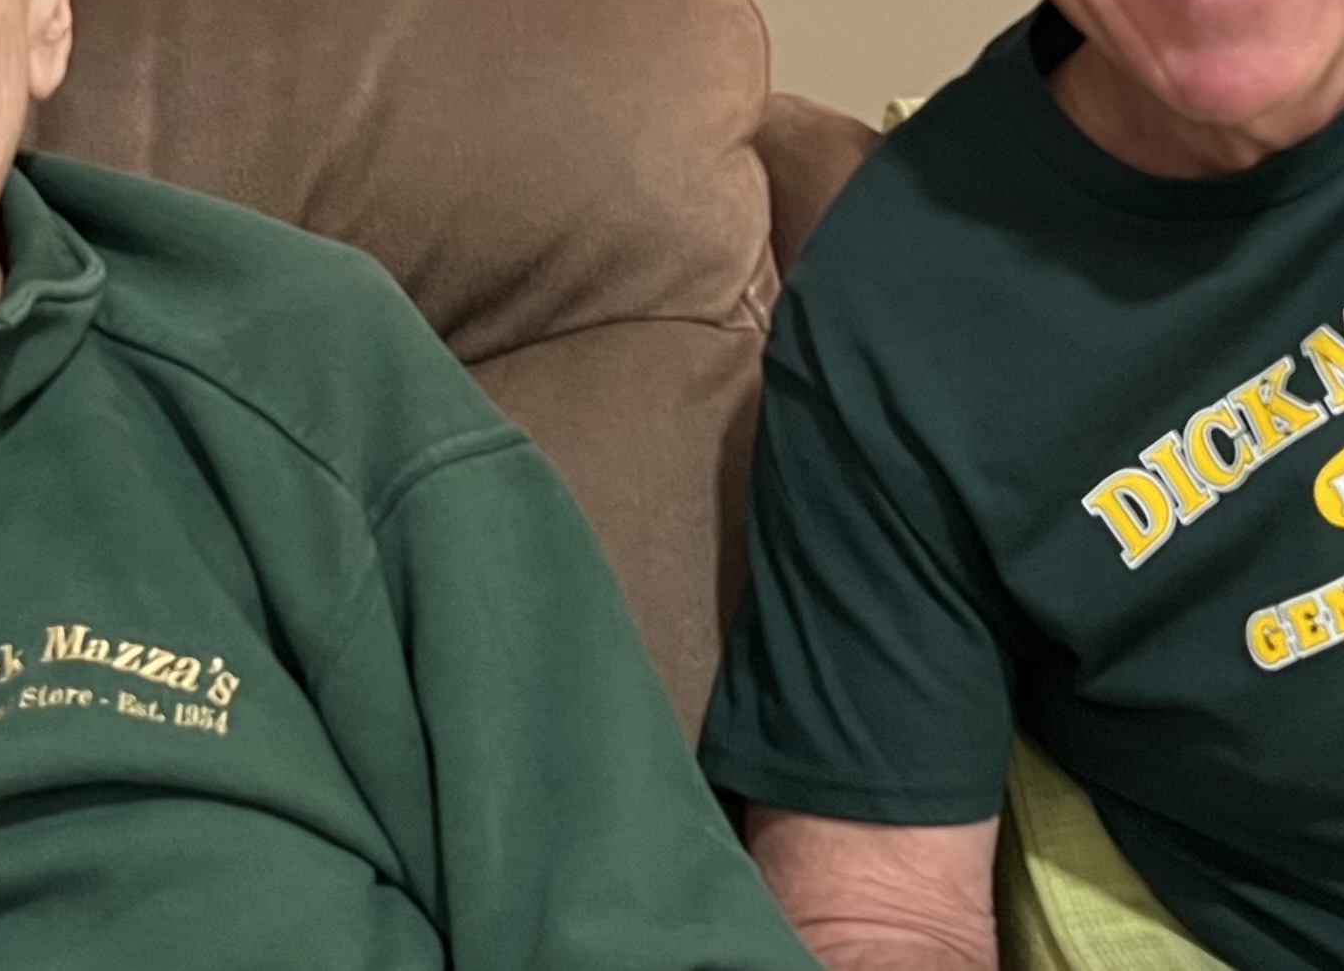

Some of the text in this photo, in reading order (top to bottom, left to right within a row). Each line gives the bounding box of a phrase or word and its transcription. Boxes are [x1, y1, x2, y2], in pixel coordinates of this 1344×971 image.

[1082, 357, 1329, 569] DICK
[40, 624, 240, 706] Mazza's
[18, 685, 94, 708] Store
[117, 691, 166, 723] Est.
[174, 702, 228, 735] 1954
